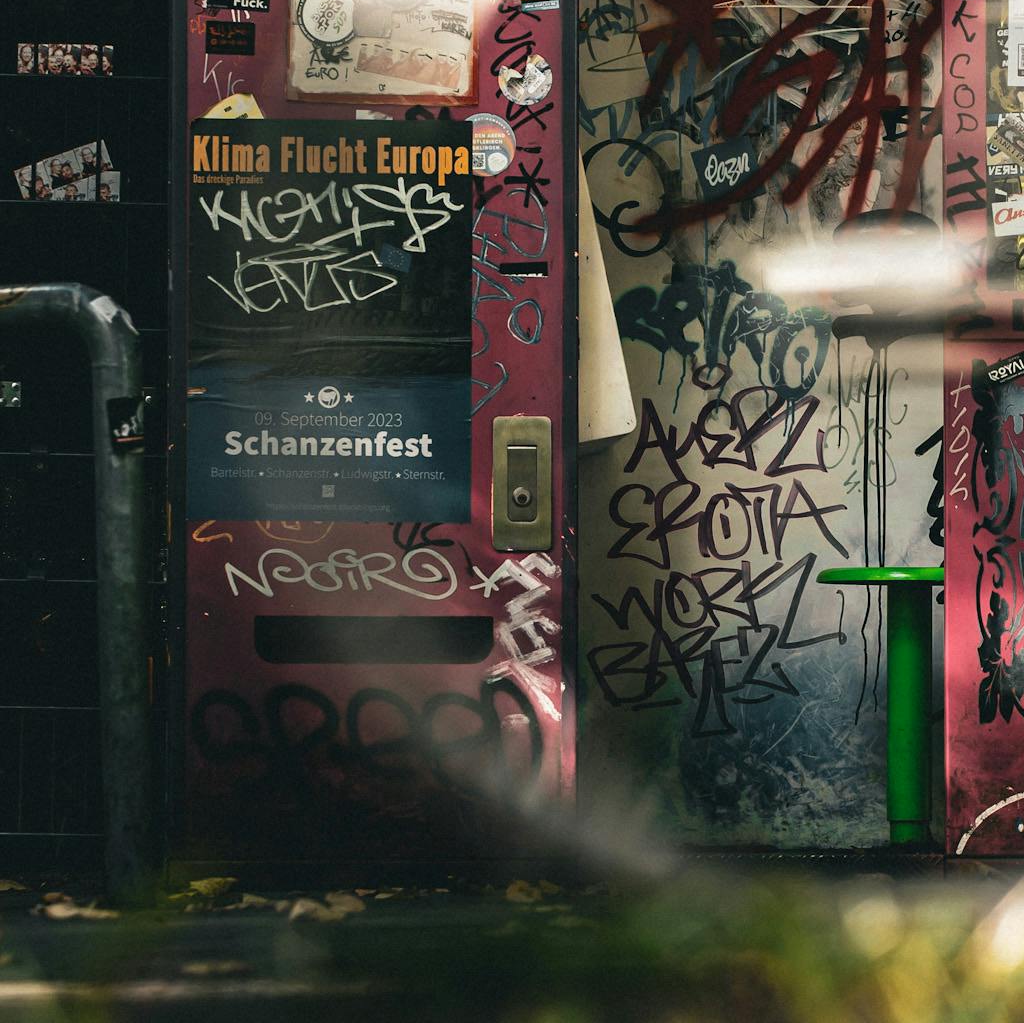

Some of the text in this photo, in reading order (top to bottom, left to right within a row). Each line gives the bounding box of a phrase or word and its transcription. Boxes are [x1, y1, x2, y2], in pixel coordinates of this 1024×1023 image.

[193, 135, 469, 187] Klima Flucht Europa
[254, 412, 403, 430] 09. September 2023
[224, 430, 433, 458] Schanzenfest
[402, 468, 446, 481] Sternstr.
